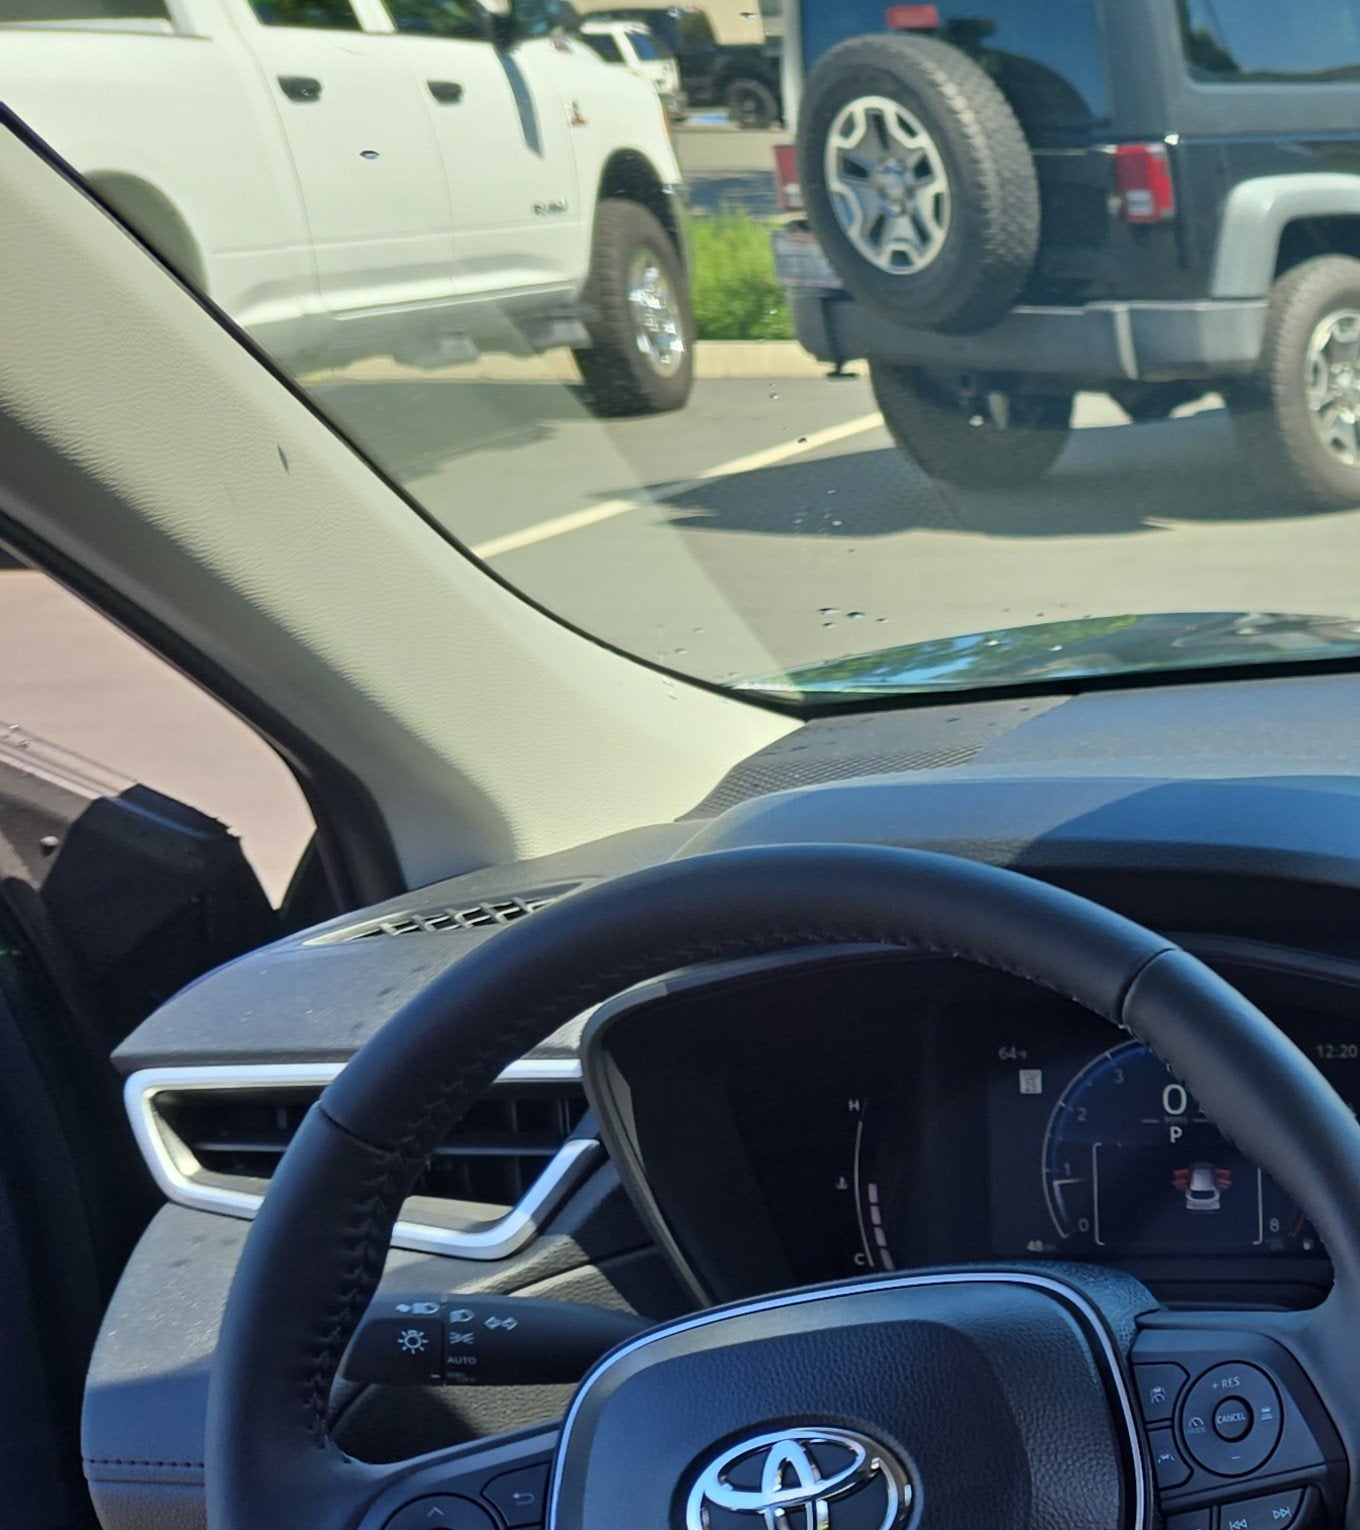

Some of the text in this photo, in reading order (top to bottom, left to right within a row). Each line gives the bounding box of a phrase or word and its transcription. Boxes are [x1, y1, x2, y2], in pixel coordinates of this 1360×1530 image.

[1162, 1083, 1188, 1116] 0
[1169, 1126, 1183, 1143] P
[447, 1356, 477, 1366] AUTO
[1220, 1376, 1241, 1389] RES
[1216, 1411, 1246, 1424] CANCEL
